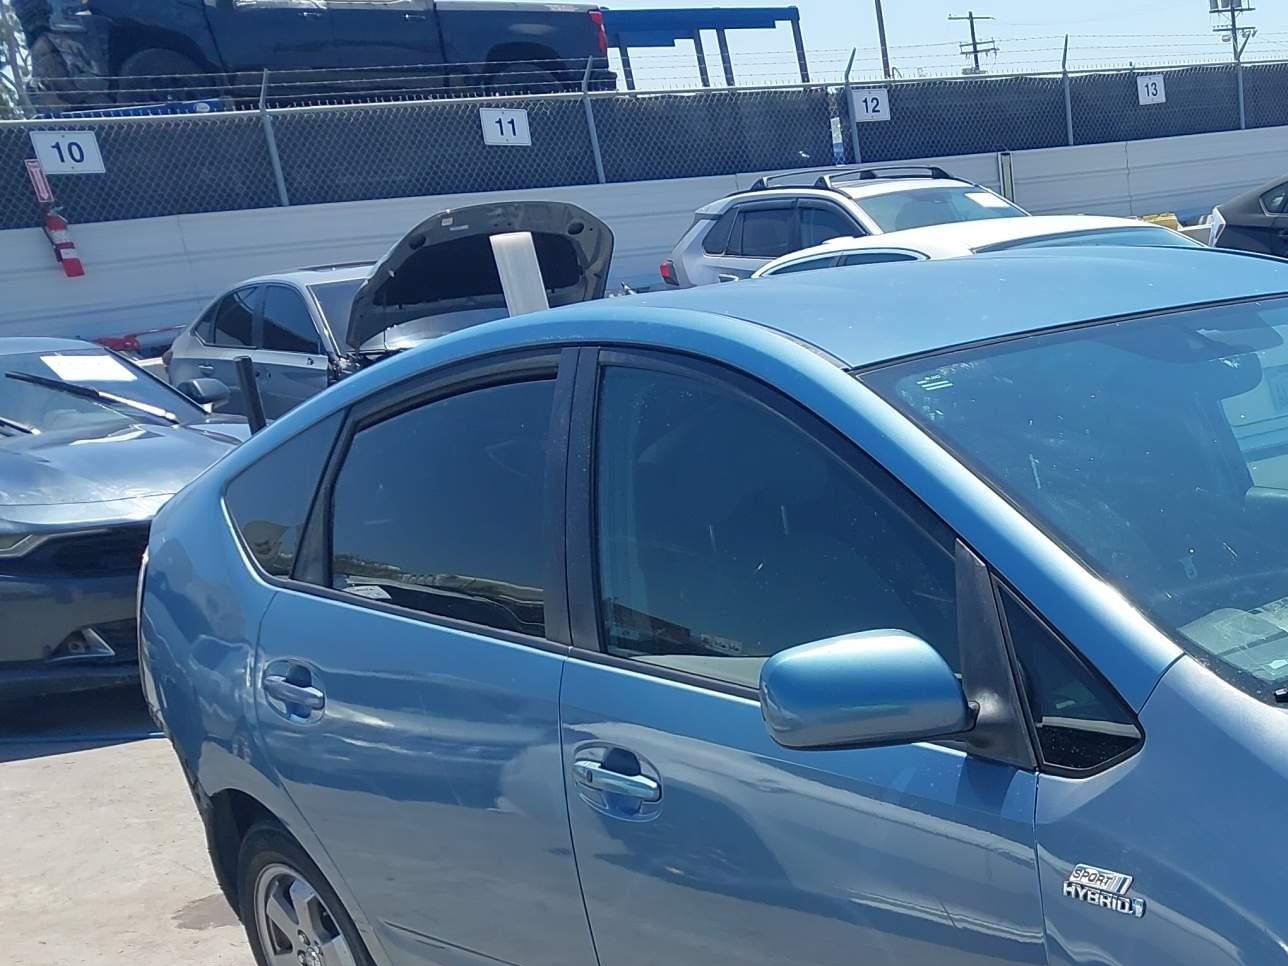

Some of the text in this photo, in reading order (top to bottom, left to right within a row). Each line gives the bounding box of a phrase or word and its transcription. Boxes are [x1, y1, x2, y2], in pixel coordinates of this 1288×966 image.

[1144, 82, 1158, 97] 13
[862, 97, 880, 113] 12
[495, 117, 516, 137] 11
[50, 142, 84, 163] 10
[1073, 867, 1113, 887] SPORT
[1063, 881, 1133, 914] HYBRID
